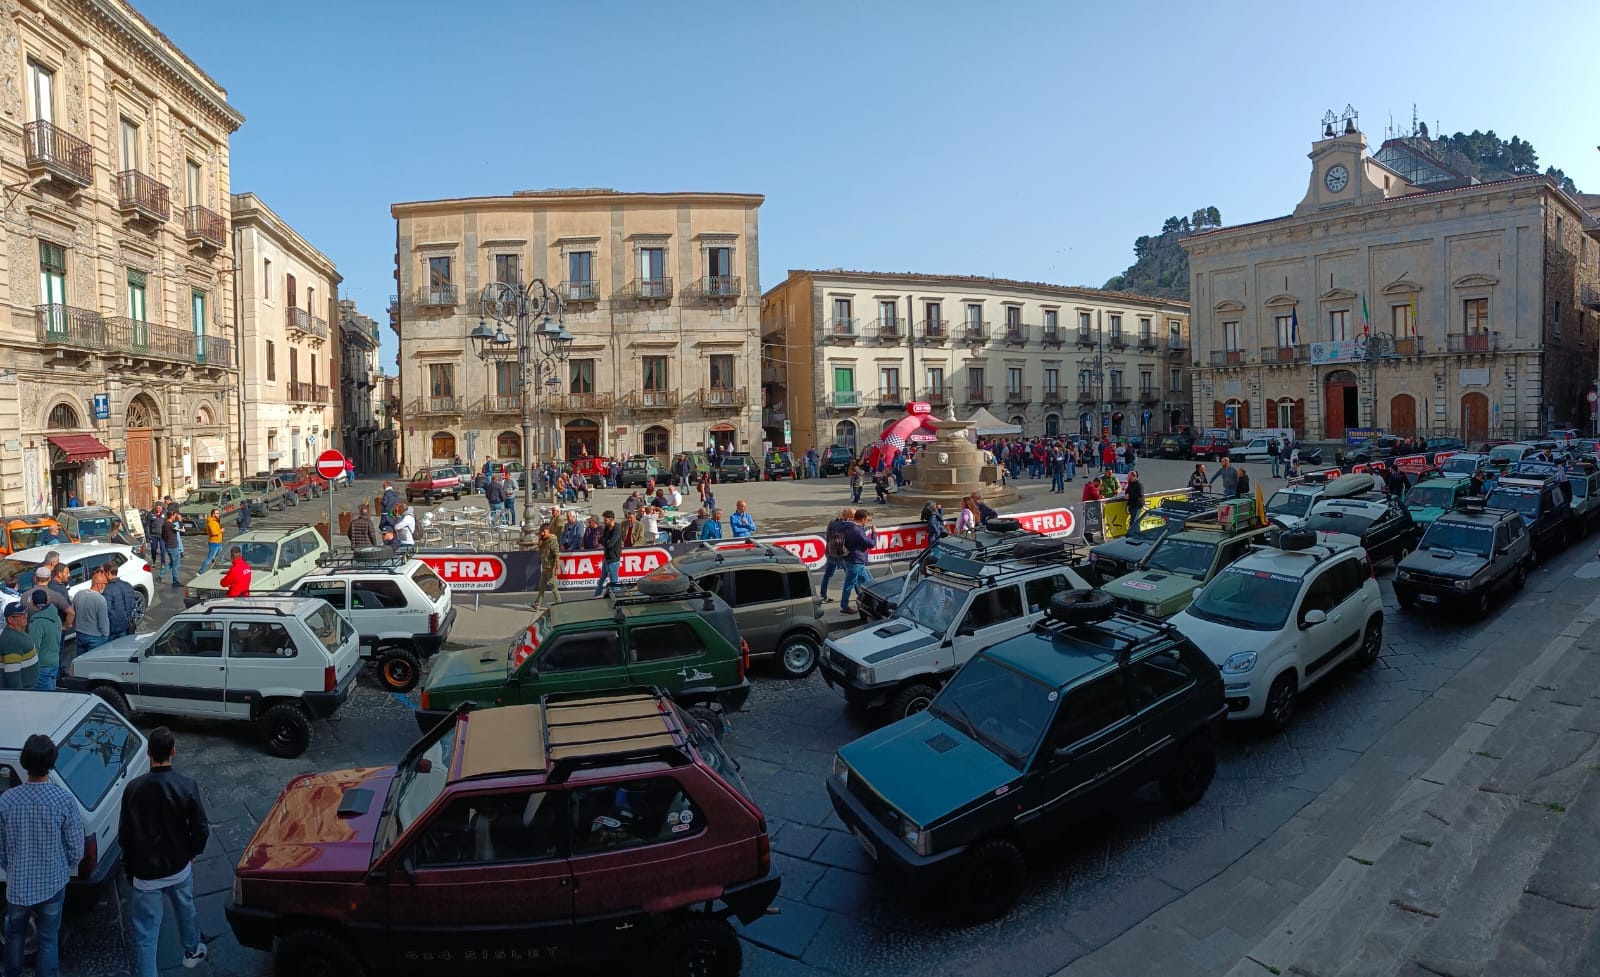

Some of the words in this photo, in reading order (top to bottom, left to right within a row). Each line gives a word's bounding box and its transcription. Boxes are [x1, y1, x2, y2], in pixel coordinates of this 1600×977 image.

[1032, 514, 1068, 531] FRA
[784, 543, 818, 559] RA
[444, 561, 495, 577] FRA
[557, 558, 595, 575] MA
[620, 555, 660, 573] RA
[561, 577, 595, 586] cosmetici
